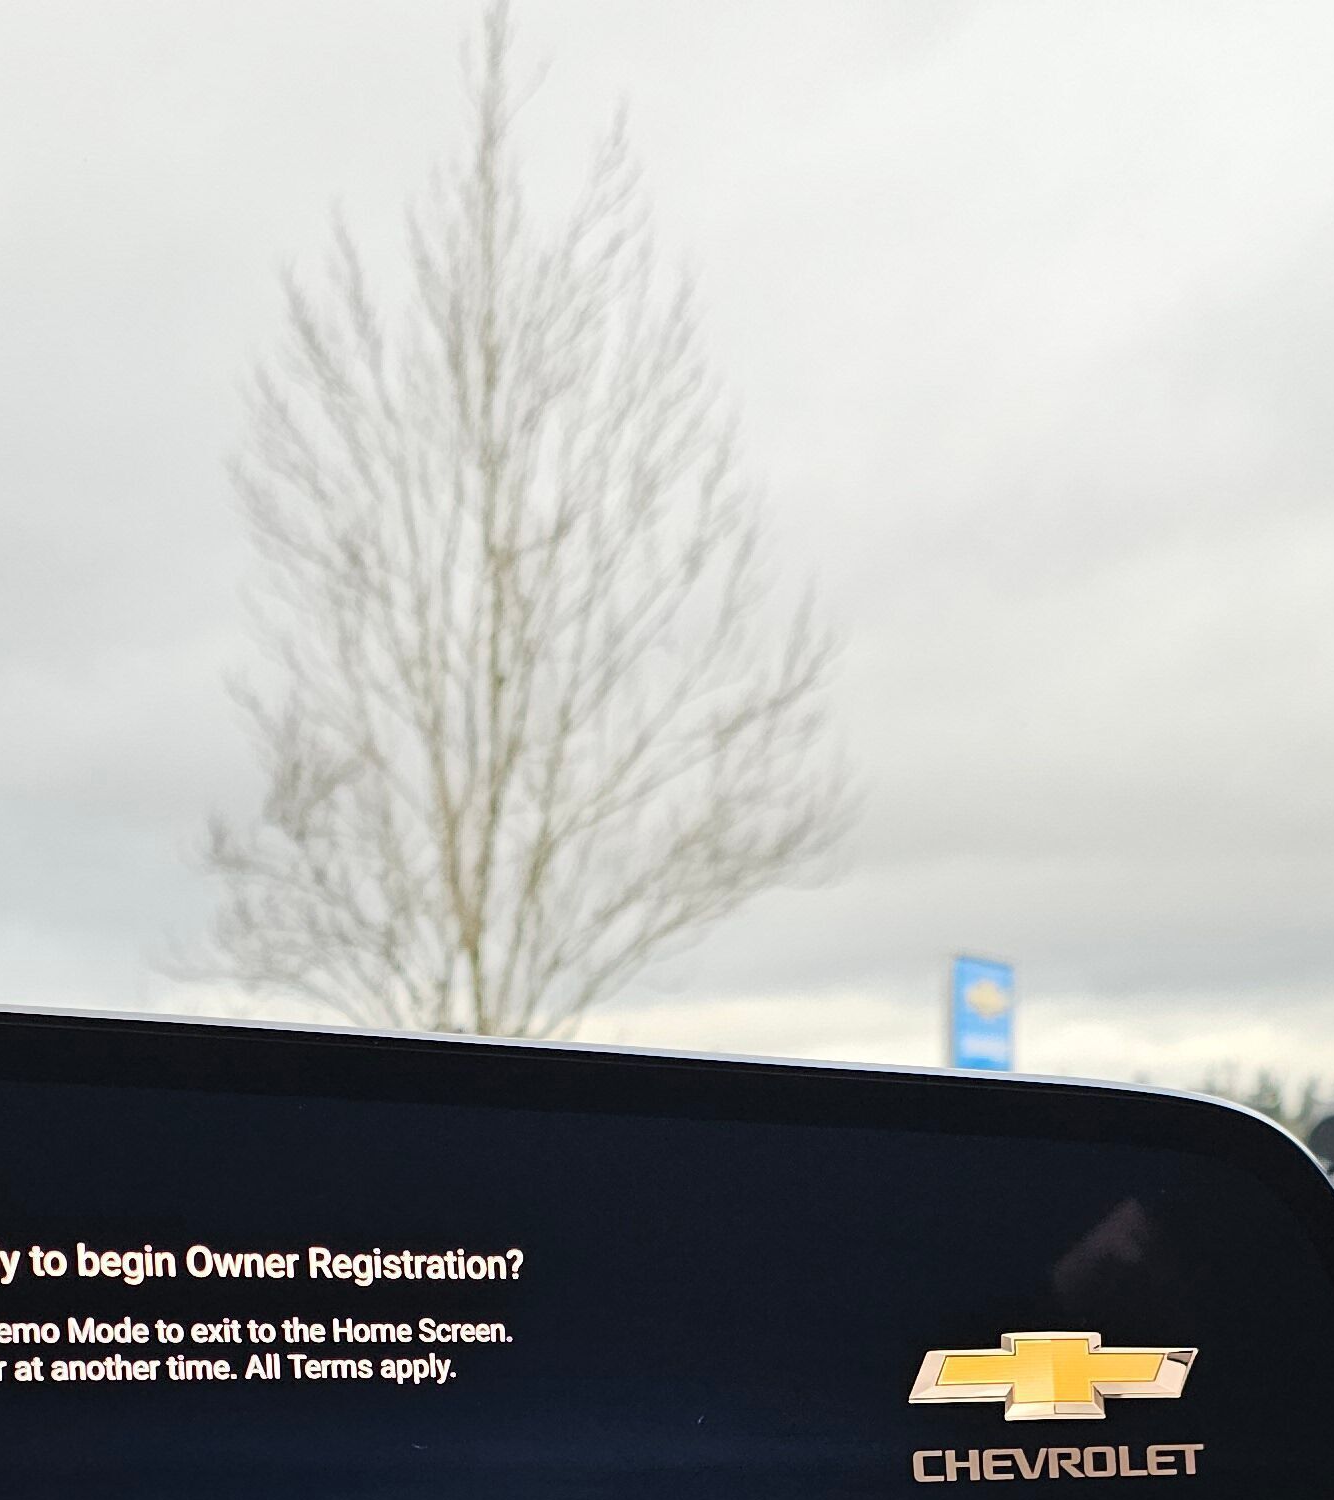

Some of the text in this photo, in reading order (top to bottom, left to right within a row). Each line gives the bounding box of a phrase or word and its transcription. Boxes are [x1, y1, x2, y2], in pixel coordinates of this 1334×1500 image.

[28, 1245, 68, 1277] to
[76, 1242, 177, 1286] begin
[185, 1244, 300, 1279] Owner
[308, 1246, 524, 1287] Registration?
[67, 1316, 150, 1344] Mode
[154, 1319, 184, 1344] to
[190, 1317, 242, 1344] exit
[247, 1318, 276, 1343] to
[281, 1316, 327, 1344] the
[332, 1317, 413, 1343] Home
[418, 1317, 514, 1343] Screen.
[13, 1356, 45, 1382] at
[50, 1354, 158, 1382] another
[165, 1354, 238, 1381] time.
[244, 1353, 281, 1380] All
[286, 1353, 374, 1380] Terms
[380, 1353, 457, 1385] apply.
[912, 1443, 1205, 1483] CHEVROLET
